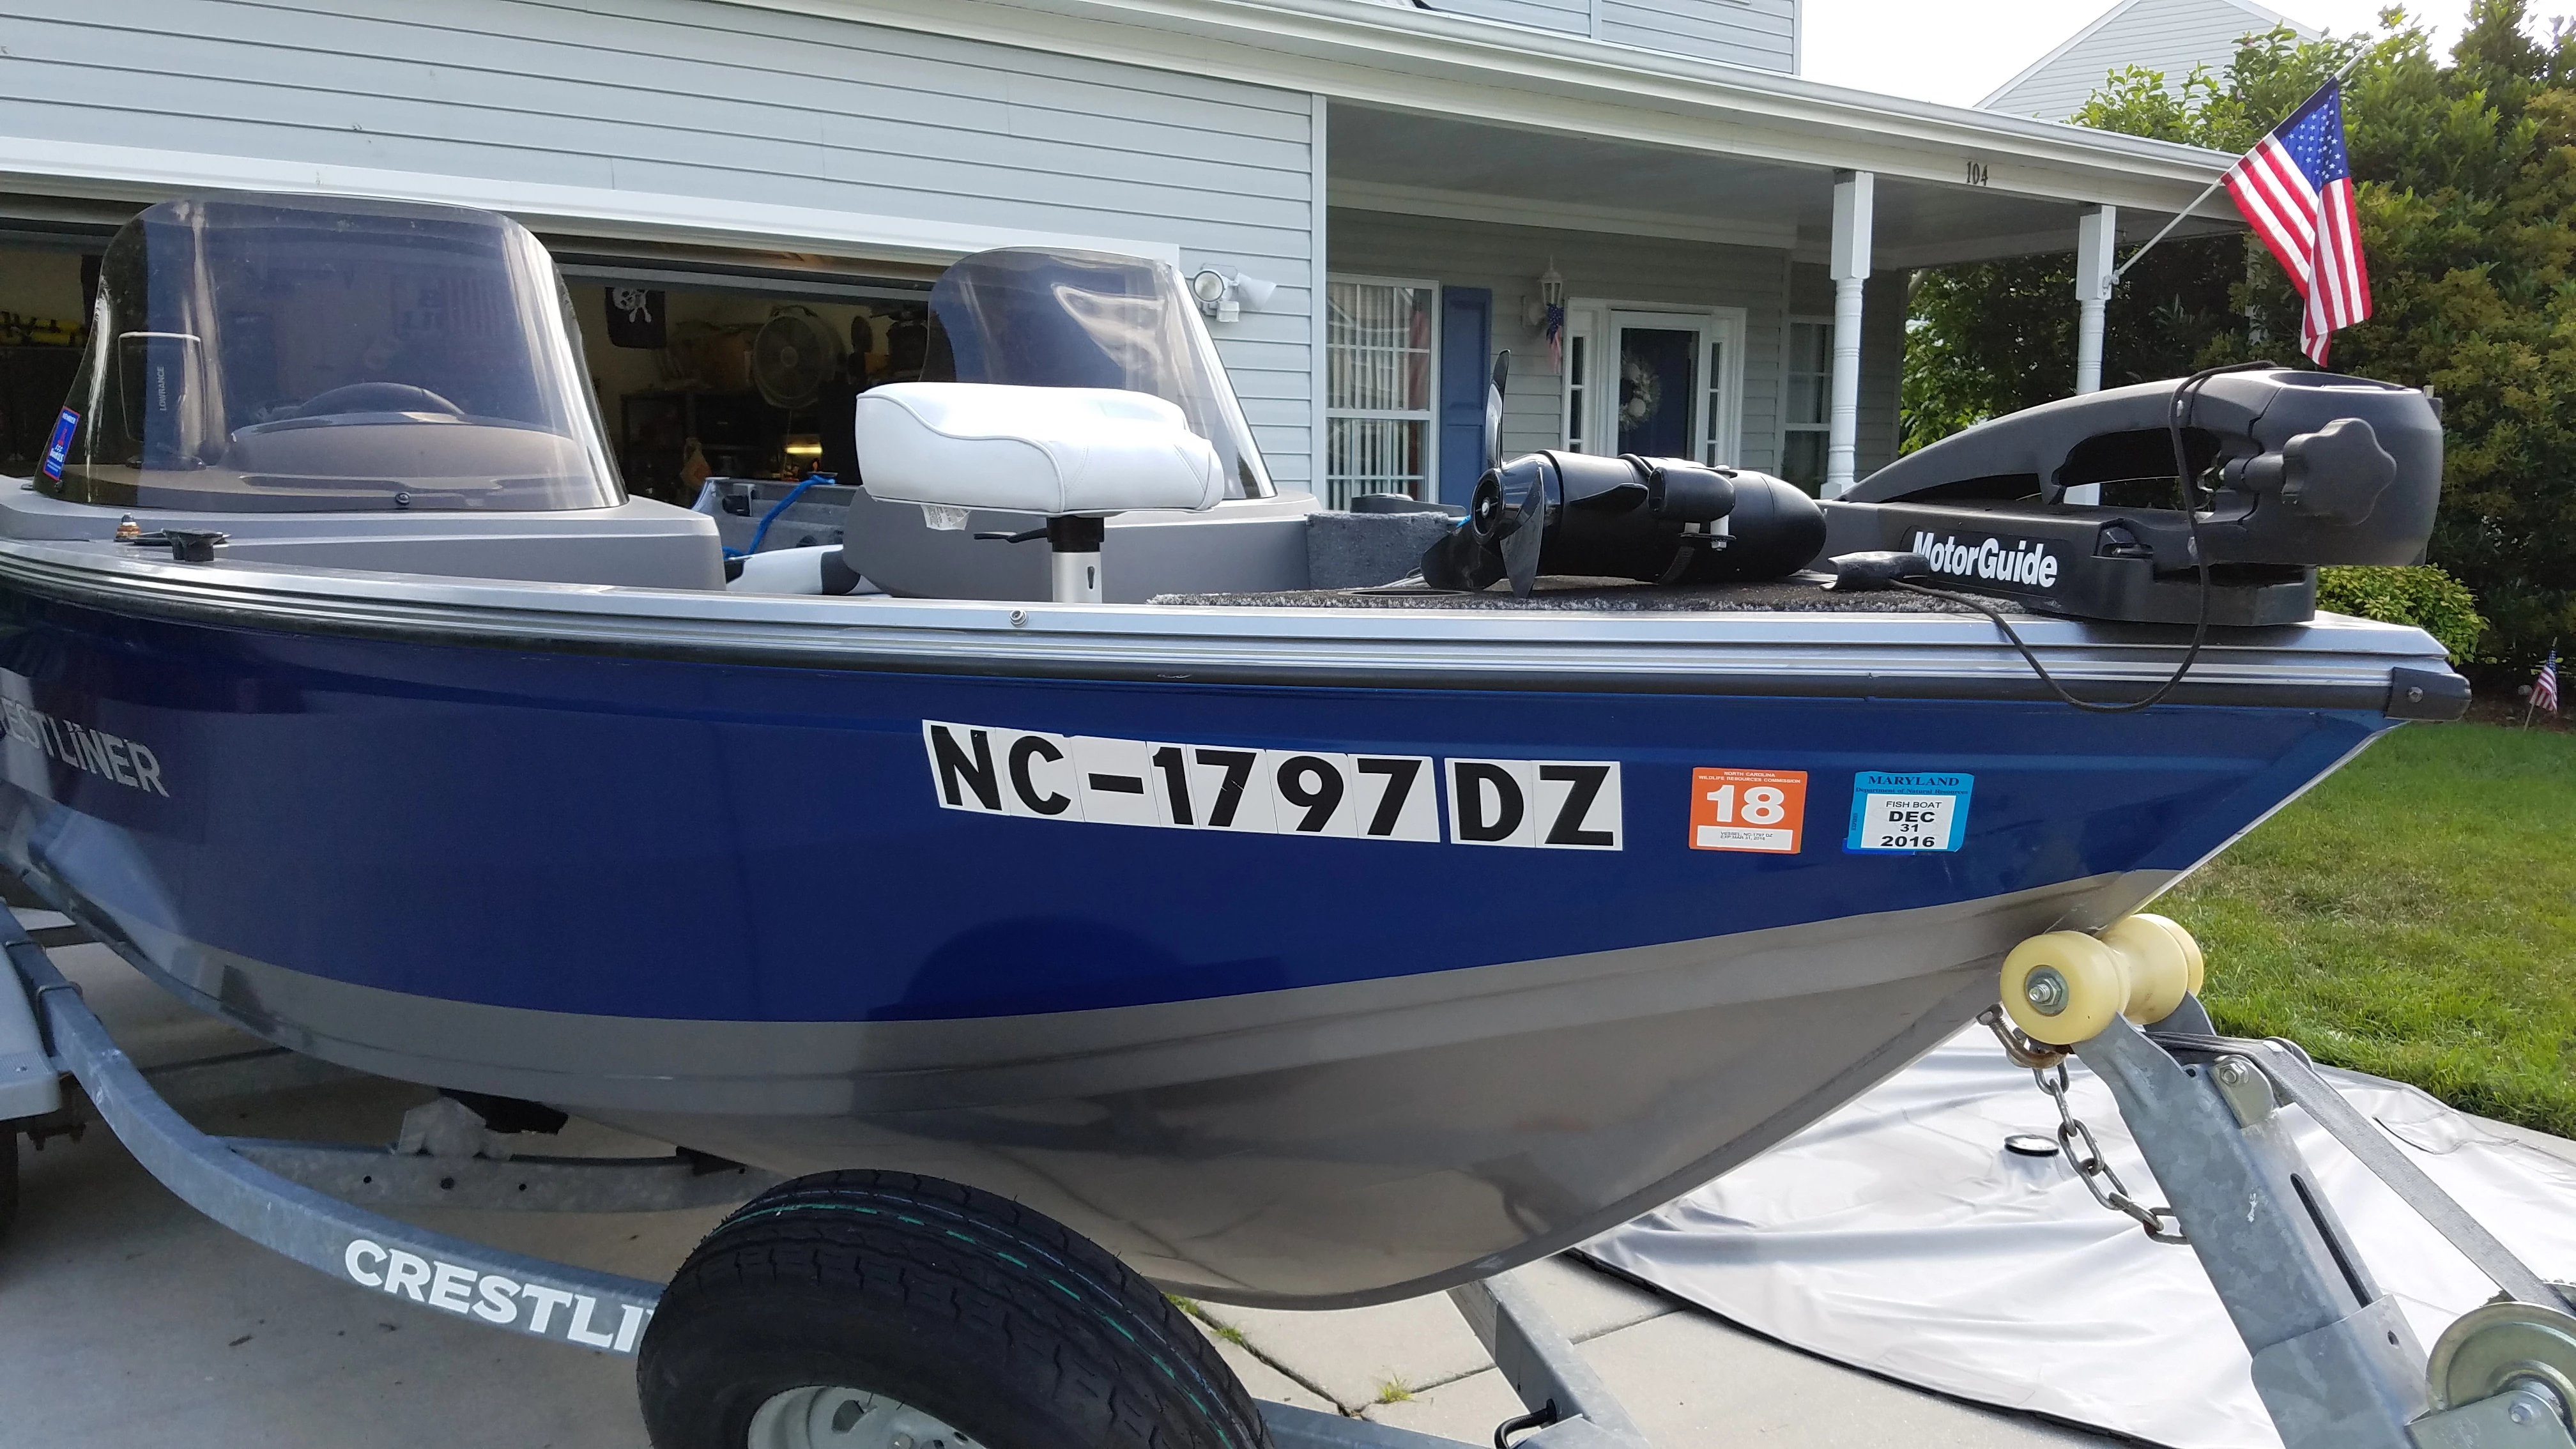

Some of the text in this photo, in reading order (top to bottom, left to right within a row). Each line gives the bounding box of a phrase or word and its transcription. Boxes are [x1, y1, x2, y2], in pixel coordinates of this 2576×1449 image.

[1966, 161, 1988, 186] 104
[157, 366, 166, 411] LOWRANCE
[1912, 531, 2058, 588] MotorGuide
[0, 696, 170, 798] ESTLINER
[930, 724, 1615, 847] NC-1797 DZ
[1868, 776, 1959, 786] MARYLAND
[1706, 784, 1785, 825] 18
[1889, 811, 1935, 823] DEC
[1880, 836, 1935, 847] 2016
[1899, 824, 1919, 832] 31
[344, 1239, 654, 1353] CRESTLI
